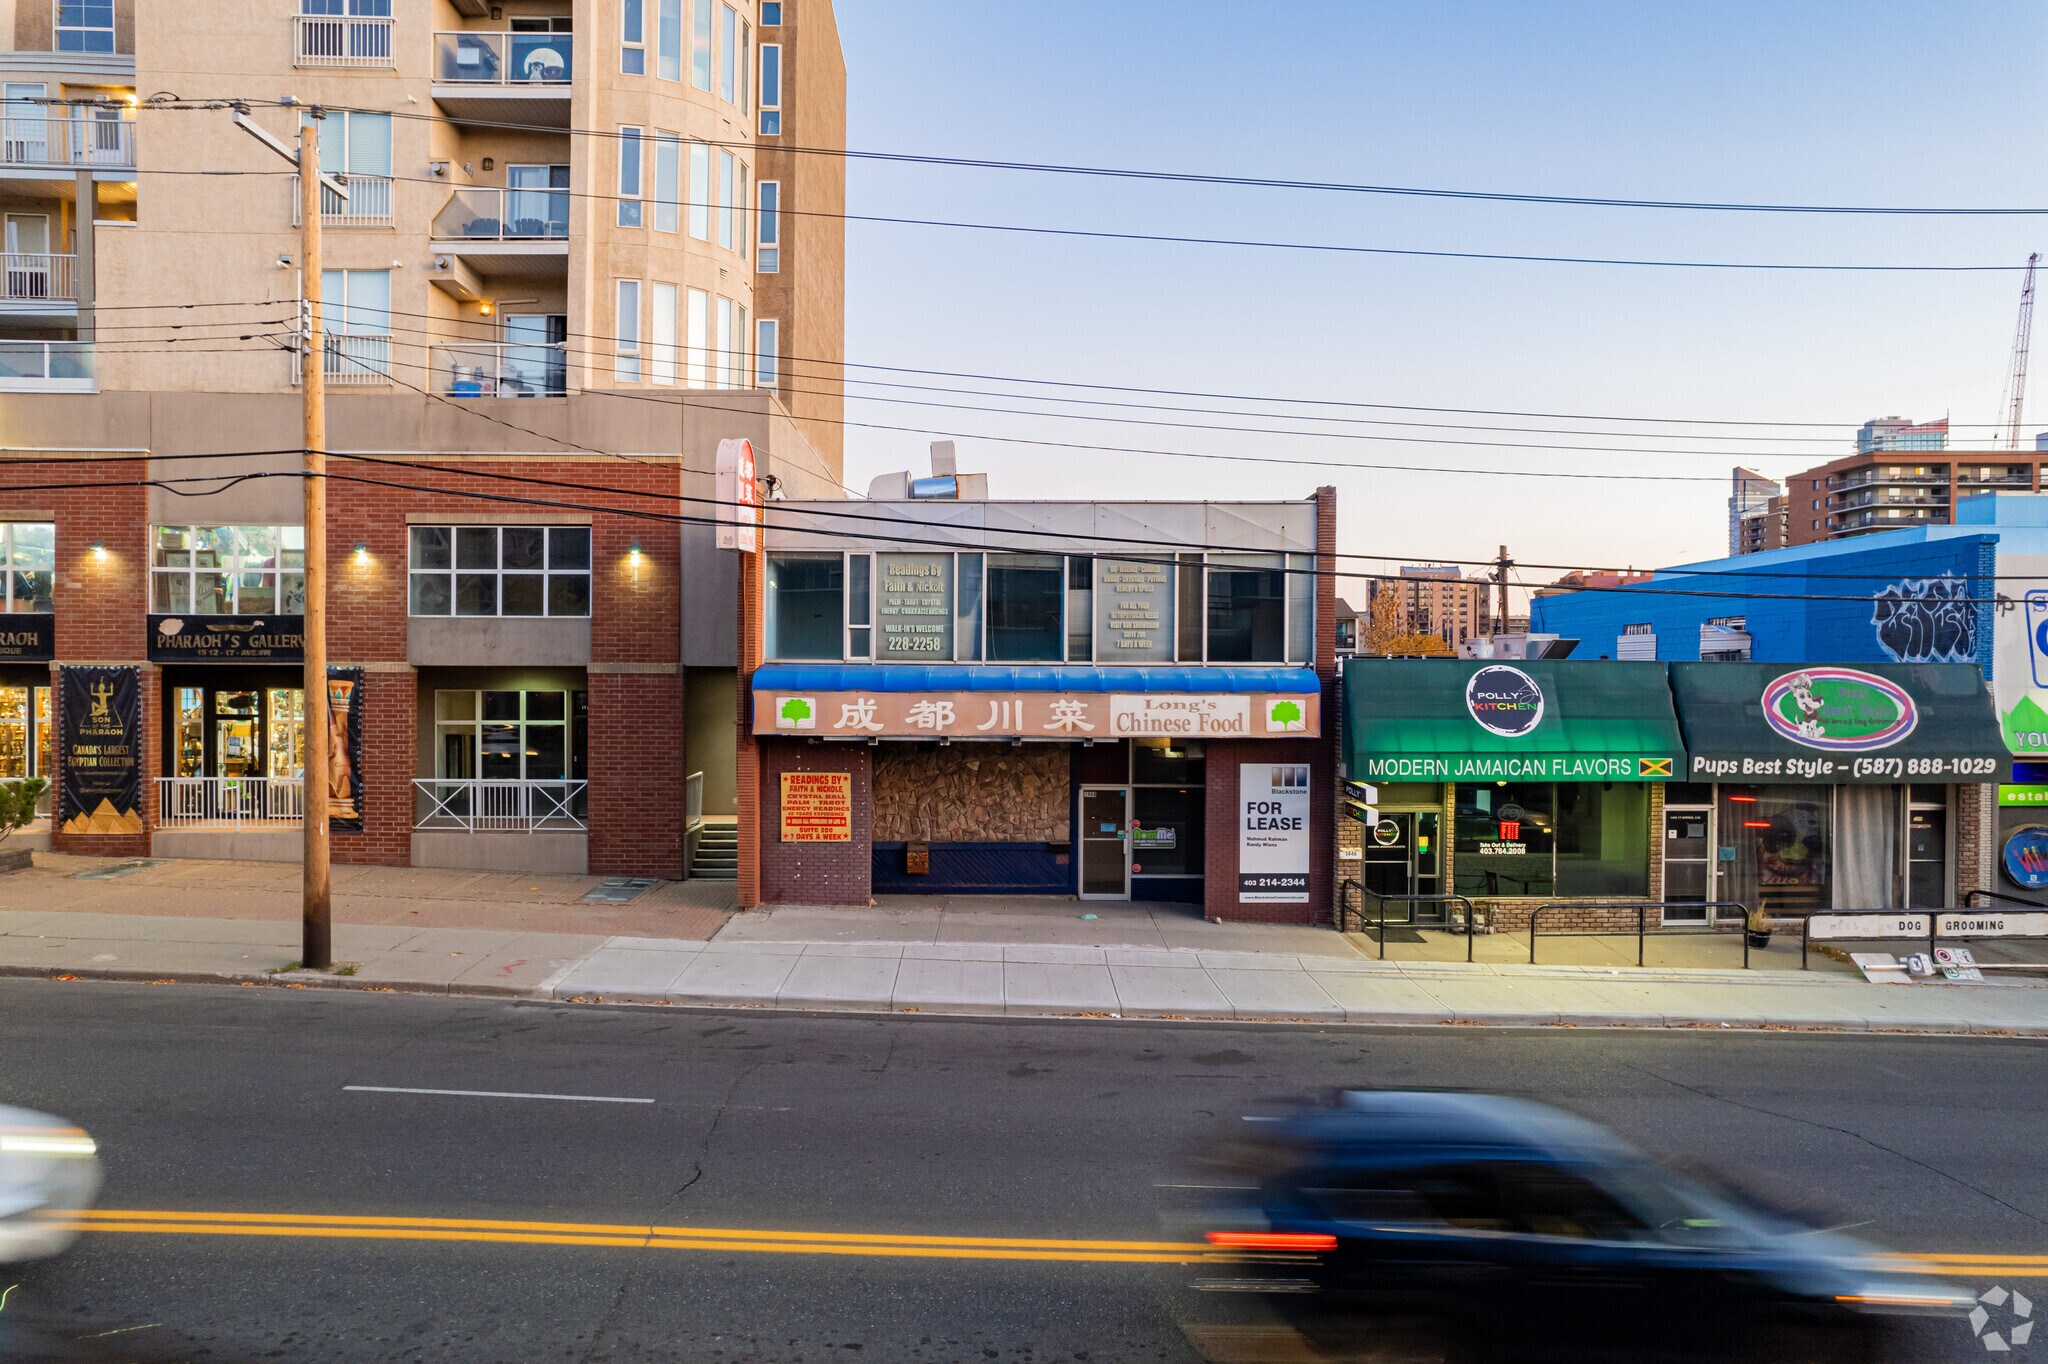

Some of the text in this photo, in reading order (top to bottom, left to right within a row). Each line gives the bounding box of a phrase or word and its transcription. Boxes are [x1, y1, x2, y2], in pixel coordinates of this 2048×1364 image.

[889, 563, 942, 577] Readings By
[884, 580, 906, 592] Faith
[907, 581, 913, 592] &
[885, 624, 944, 633] WALK-IN'S WELCOME
[157, 634, 240, 648] PHARAOH'S
[888, 636, 941, 651] 228-2258
[1144, 699, 1217, 712] Long's
[1474, 702, 1537, 710] KITCHEN
[833, 698, 1095, 732] 成都川菜
[1116, 712, 1244, 732] Chinese Food
[1369, 758, 1631, 776] MODERN JAMAICAN FLAVORS
[1693, 756, 1738, 777] Pups
[1742, 758, 1781, 775] Best
[1786, 758, 1833, 778] Style
[1853, 758, 1903, 778] (587)
[1907, 758, 1996, 774] 888-1029
[790, 775, 842, 784] READINGS BY
[1247, 802, 1282, 814] FOR
[1247, 817, 1302, 830] LEASE
[1259, 878, 1305, 886] 214-2344
[1899, 920, 2004, 930] DOG GROOMING
